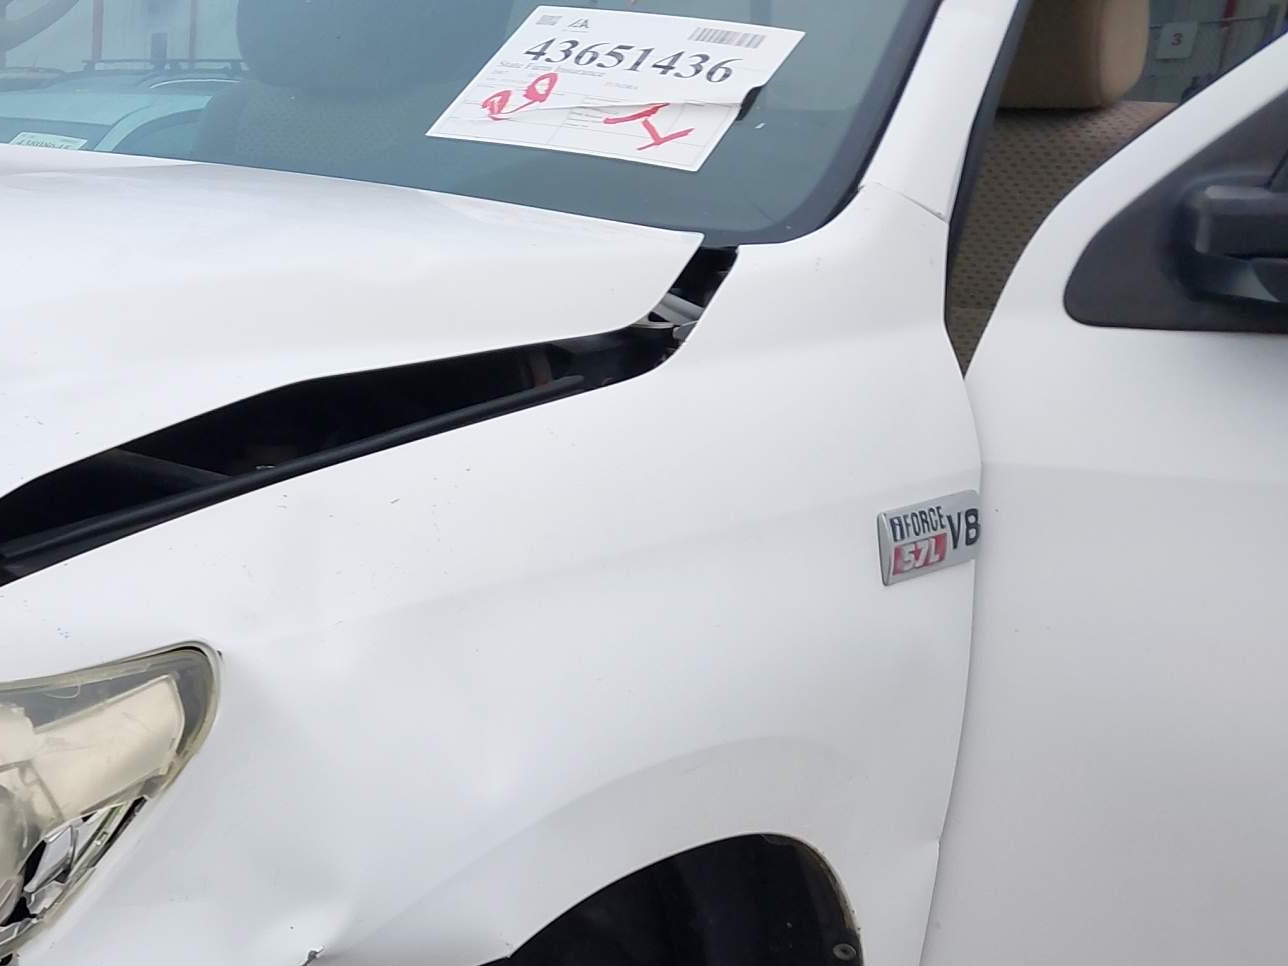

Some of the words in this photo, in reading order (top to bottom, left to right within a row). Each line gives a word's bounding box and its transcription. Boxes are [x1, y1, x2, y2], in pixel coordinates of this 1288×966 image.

[522, 37, 745, 83] 43651436
[1171, 32, 1184, 47] 3
[946, 508, 981, 550] V8
